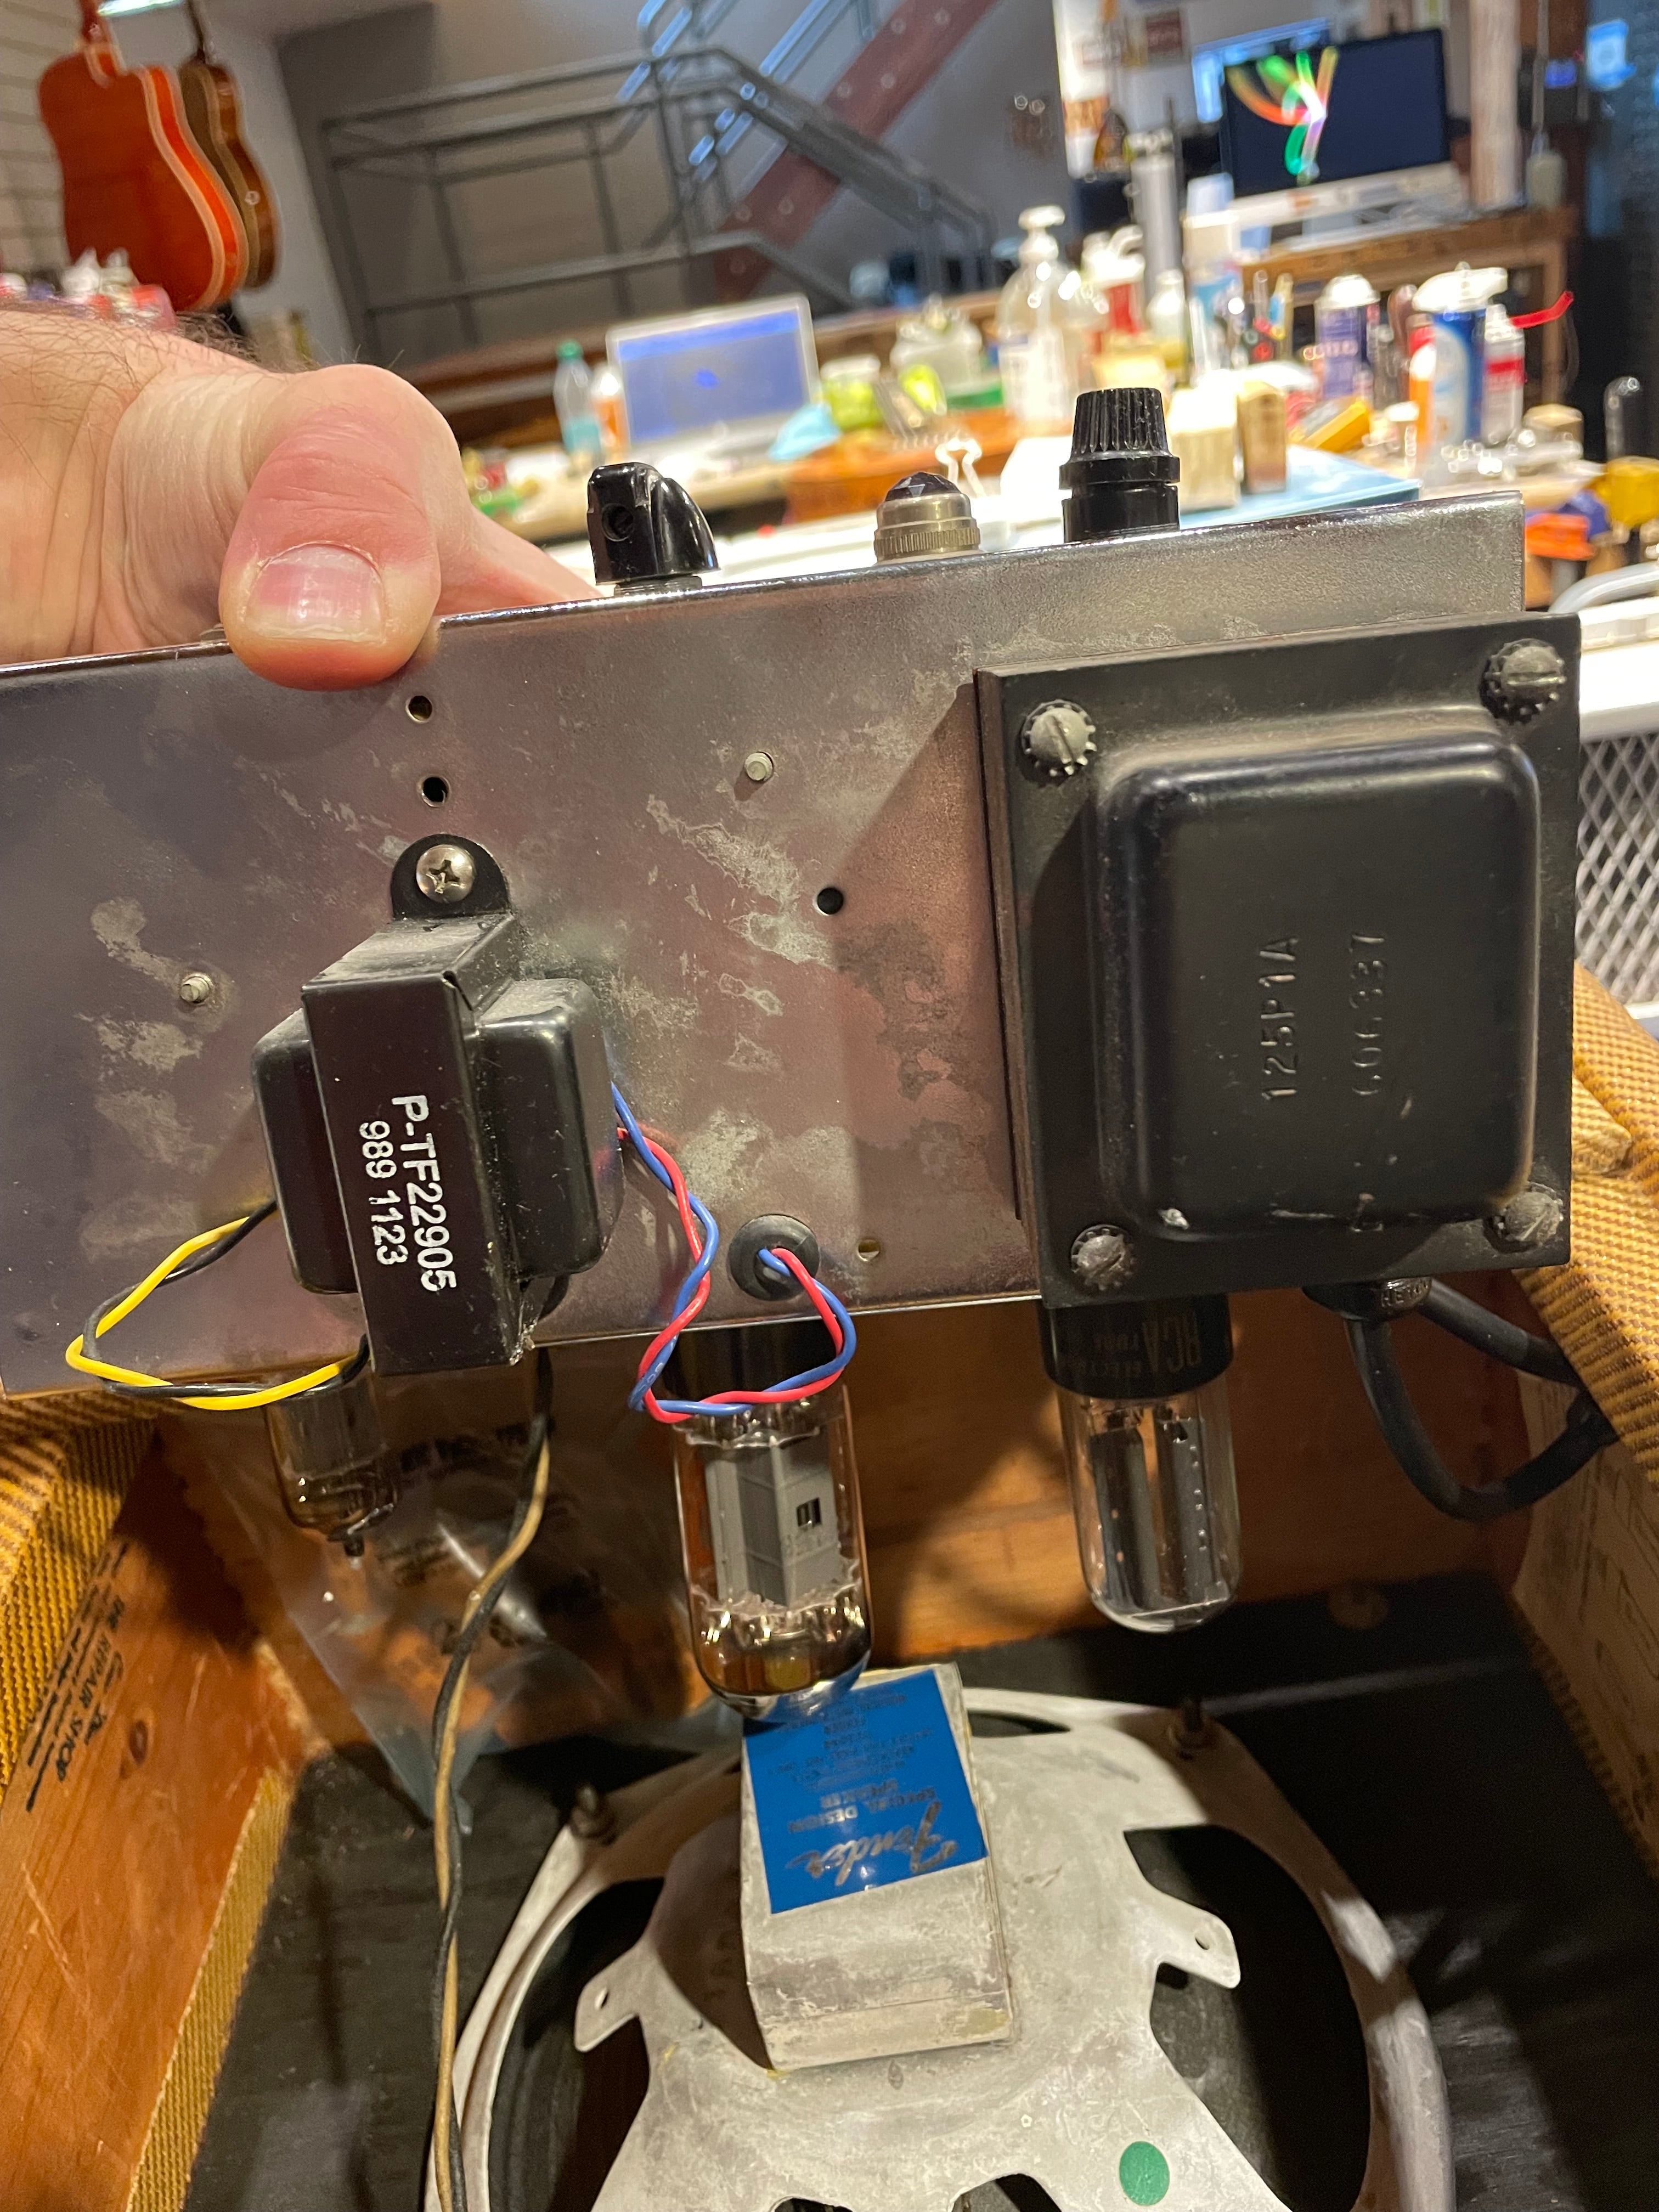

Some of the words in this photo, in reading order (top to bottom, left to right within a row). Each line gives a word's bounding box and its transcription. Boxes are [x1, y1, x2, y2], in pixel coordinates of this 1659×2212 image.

[1257, 936, 1300, 1101] 125P1A
[359, 1120, 397, 1179] 989
[368, 1189, 409, 1266] 1123
[391, 1094, 456, 1291] P-TF22905
[786, 1801, 958, 1886] Fender
[789, 1805, 858, 1834] DESIGN
